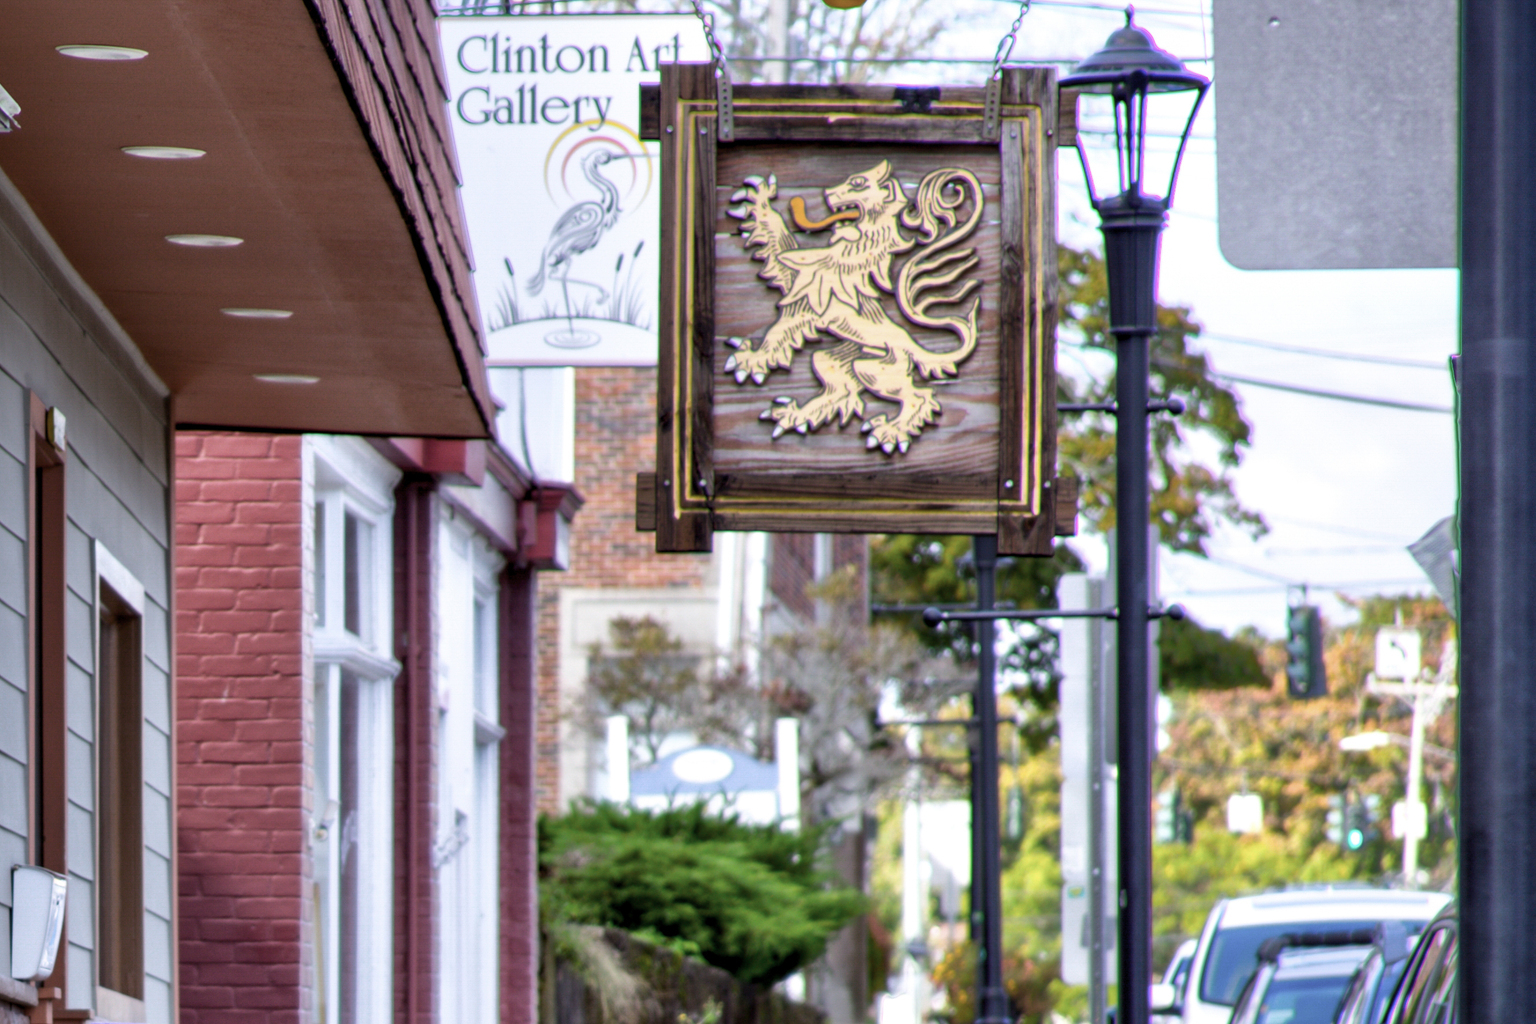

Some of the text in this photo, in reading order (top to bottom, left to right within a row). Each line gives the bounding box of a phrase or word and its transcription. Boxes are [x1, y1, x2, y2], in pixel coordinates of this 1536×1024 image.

[456, 31, 683, 74] Clinton Art
[456, 83, 612, 132] Gallery
